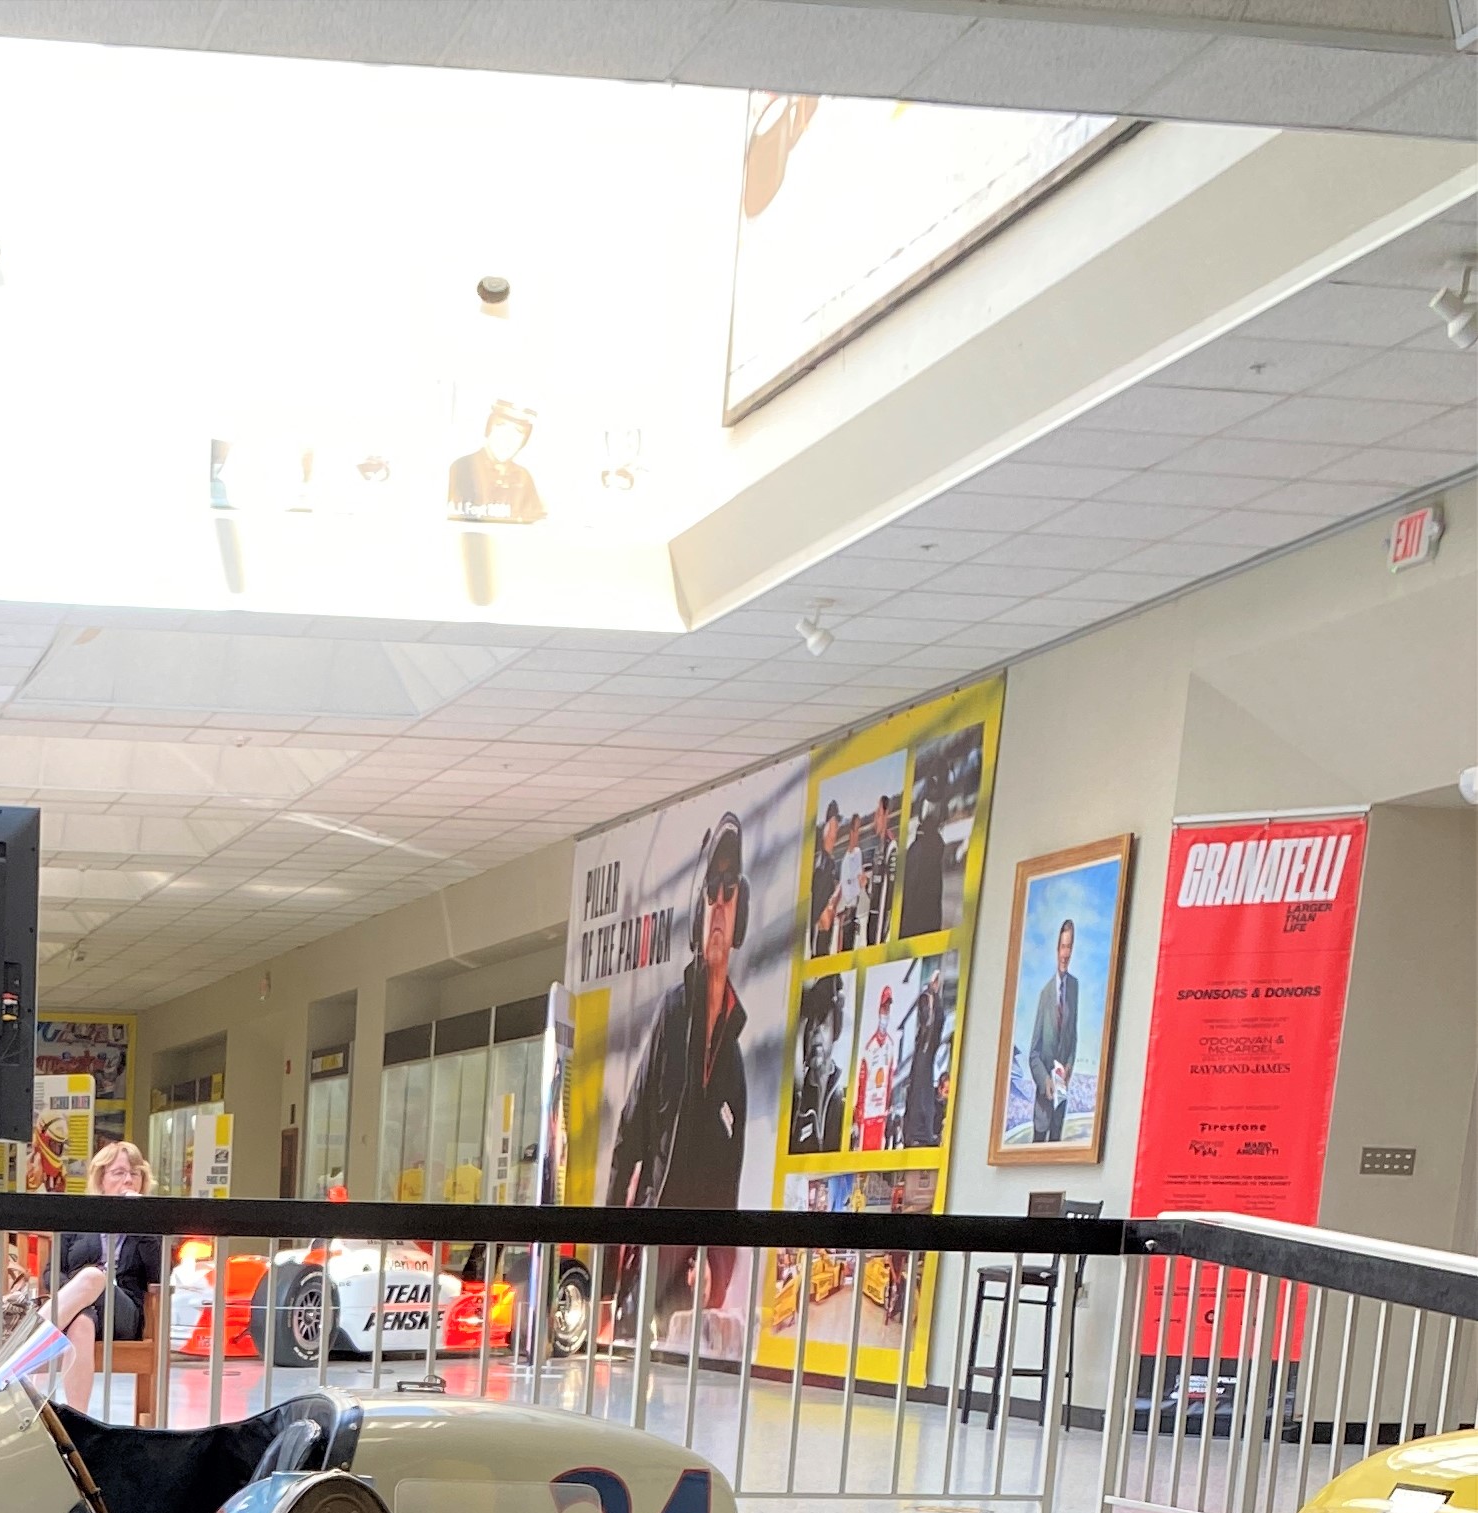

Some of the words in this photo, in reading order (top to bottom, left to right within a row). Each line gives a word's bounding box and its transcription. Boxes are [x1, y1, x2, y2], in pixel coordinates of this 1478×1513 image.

[1392, 509, 1429, 563] EXIT
[1177, 834, 1352, 908] GRANATELLI
[583, 861, 621, 921] PILLAR
[1287, 902, 1333, 914] LARGER
[1286, 912, 1317, 923] THAN
[1283, 922, 1307, 933] LIFE
[580, 930, 595, 982] OF
[595, 924, 616, 979] THE
[617, 907, 675, 974] PADDOCK
[1176, 988, 1248, 1000] SPONSORS
[1251, 987, 1260, 998] &
[1264, 985, 1322, 998] DONORS
[1190, 1064, 1250, 1075] RAYMOND
[1250, 1063, 1291, 1074] JAMES
[1199, 1123, 1267, 1133] Firestone
